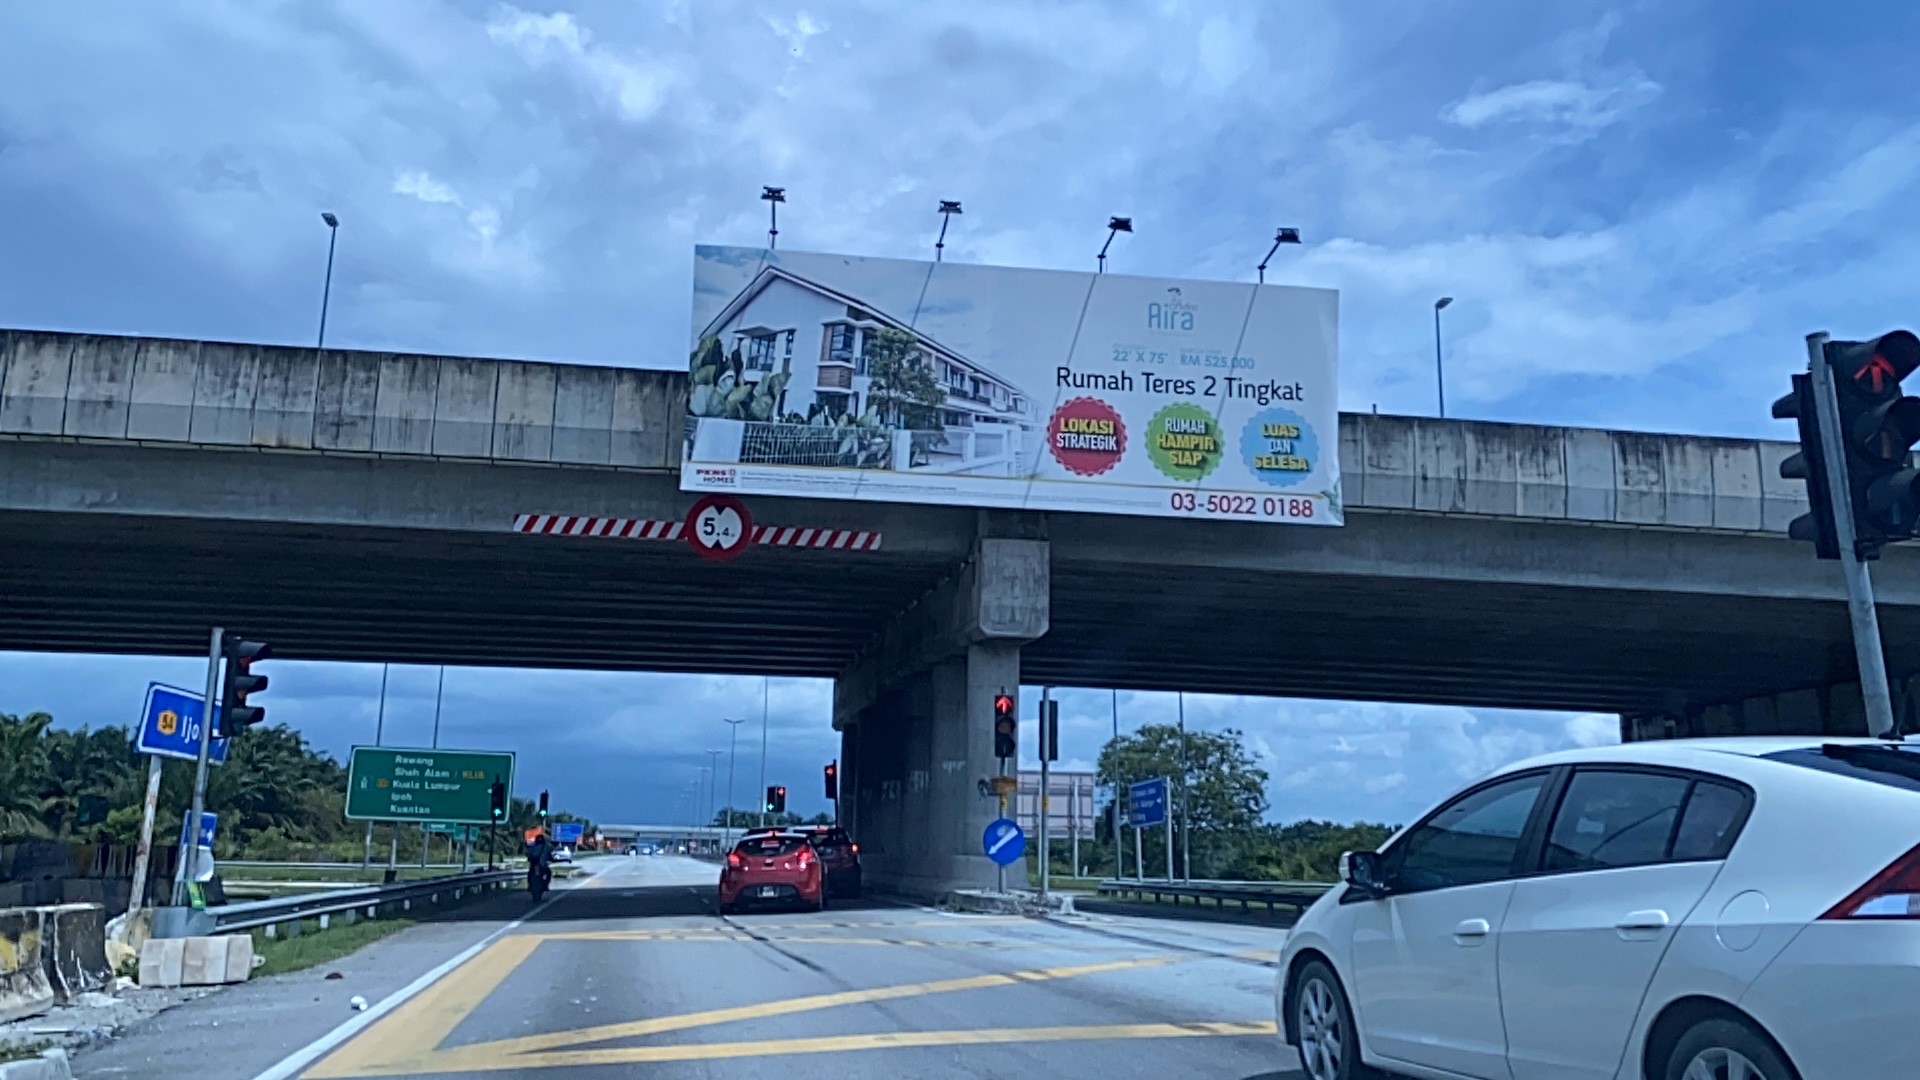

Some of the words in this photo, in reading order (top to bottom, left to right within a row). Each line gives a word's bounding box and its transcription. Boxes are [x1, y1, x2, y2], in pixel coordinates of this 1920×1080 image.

[1180, 354, 1200, 366] RM
[1056, 367, 1133, 392] Rumah
[1141, 372, 1196, 395] Teres
[1203, 375, 1217, 397] 2
[1224, 377, 1303, 406] Tingkat
[1060, 417, 1114, 434] LOKASI
[1165, 418, 1205, 433] RUMAH
[1262, 423, 1298, 437] LUAS
[1056, 433, 1117, 450] STRATEGIK
[1157, 434, 1214, 450] HAMPIR
[1270, 439, 1291, 453] DAN
[1169, 451, 1202, 466] SIAP
[1254, 455, 1309, 470] SELESA
[1171, 493, 1257, 515] 03-5022
[1263, 498, 1314, 517] 0188
[395, 755, 434, 766] Rawang
[394, 767, 420, 777] Shah
[424, 769, 450, 778] Alam
[392, 780, 420, 789] Kuala
[424, 782, 460, 791] Lumpur
[390, 805, 430, 814] Kuantan
